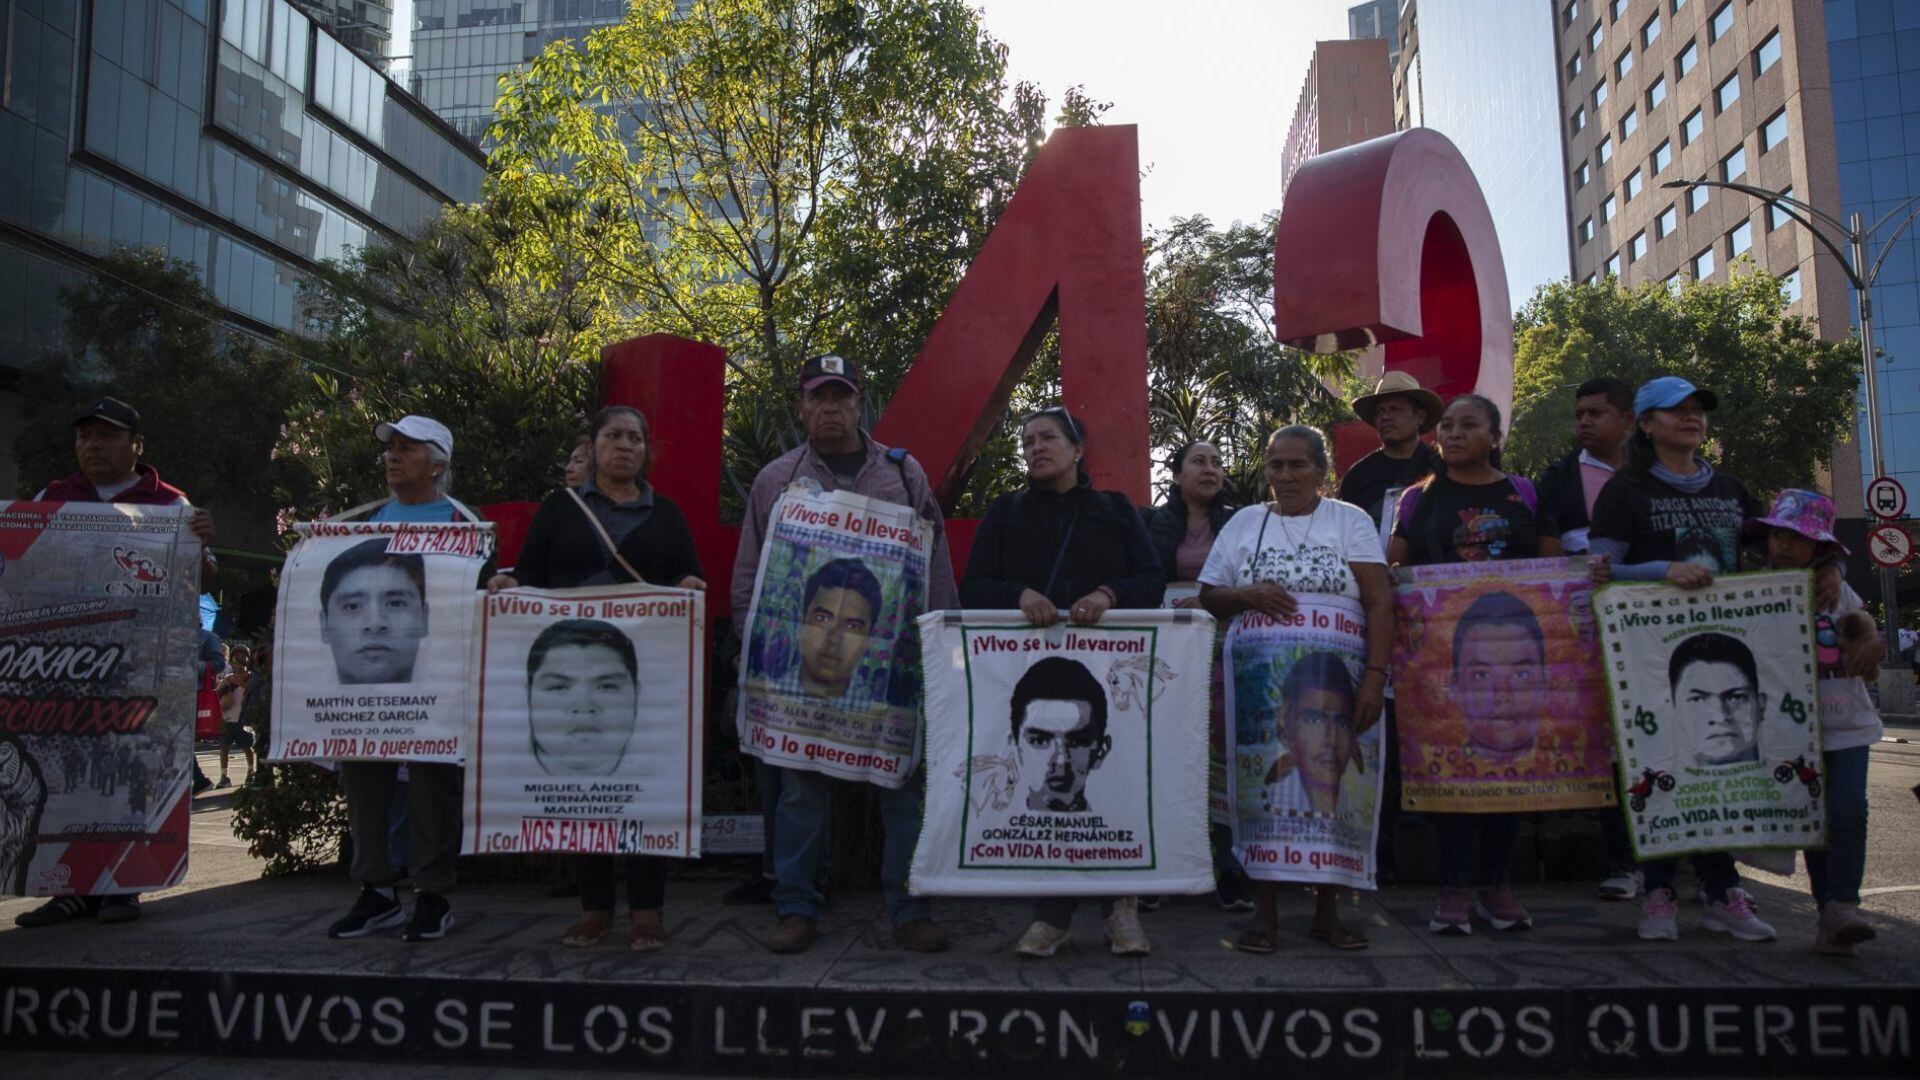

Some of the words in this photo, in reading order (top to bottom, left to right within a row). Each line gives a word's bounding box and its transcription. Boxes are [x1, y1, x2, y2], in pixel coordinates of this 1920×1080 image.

[1650, 497, 1690, 512] JORGE
[780, 502, 819, 524] ¡Vivo
[819, 511, 839, 526] se
[844, 512, 862, 532] lo
[1650, 512, 1697, 531] TIZAPA
[389, 531, 420, 552] NOS
[422, 531, 477, 555] FALTAN
[490, 597, 542, 617] ¡Vivo
[549, 604, 570, 616] se
[577, 603, 595, 618] lo
[602, 599, 686, 618] llevaron!
[1620, 613, 1661, 632] ¡Vivo
[1666, 613, 1685, 625] se
[1690, 608, 1707, 622] lo
[1711, 598, 1792, 620] llevaron!
[1281, 612, 1305, 627] se
[1312, 609, 1329, 628] lo
[974, 636, 1017, 654] ¡Vivo
[1023, 638, 1040, 651] se
[1066, 634, 1145, 653] llevaron!
[306, 695, 354, 708] MARTÍN
[358, 695, 437, 707] GETSEMANY
[1780, 693, 1806, 723] 43
[315, 710, 375, 722] SÁNCHEZ
[378, 710, 428, 721] GARCÍA
[1635, 705, 1658, 735] 43
[331, 727, 362, 736] EDAD
[383, 726, 414, 735] AÑOS
[284, 739, 316, 758] ¡Con
[323, 739, 357, 757] VIDA
[362, 738, 375, 756] lo
[380, 737, 458, 758] queremos!
[781, 735, 798, 753] lo
[805, 744, 900, 773] queremos!
[524, 784, 584, 793] MIGUEL
[588, 783, 644, 792] ÁNGEL
[1677, 781, 1719, 796] JORGE
[535, 794, 634, 803] HERNÁNDEZ
[544, 805, 624, 813] MARTÍNEZ
[1009, 815, 1052, 827] CÉSAR
[1055, 816, 1107, 827] MANUEL
[1649, 815, 1679, 832] ¡Con
[1682, 809, 1719, 824] VIDA
[1723, 807, 1739, 820] lo
[520, 820, 554, 851] NOS
[559, 820, 618, 852] FALTAN
[618, 819, 643, 853] 43!
[982, 828, 1051, 840] GONZÁLEZ
[1055, 830, 1133, 842] HERNÁNDEZ
[970, 844, 1003, 861] ¡Con
[1008, 844, 1044, 858] VIDA
[1048, 844, 1061, 858] lo
[1065, 845, 1142, 862] queremos!
[1245, 844, 1278, 866] ¡Vivo
[1284, 845, 1302, 864] lo
[208, 991, 406, 1046] VIVOS
[433, 999, 514, 1050] SE
[543, 1002, 673, 1055] LOS
[715, 1006, 1099, 1059] LLEVRON
[1156, 1007, 1382, 1060] VIVOS
[1413, 1006, 1553, 1060] LOS
[1588, 1004, 1910, 1058] QUEREM
